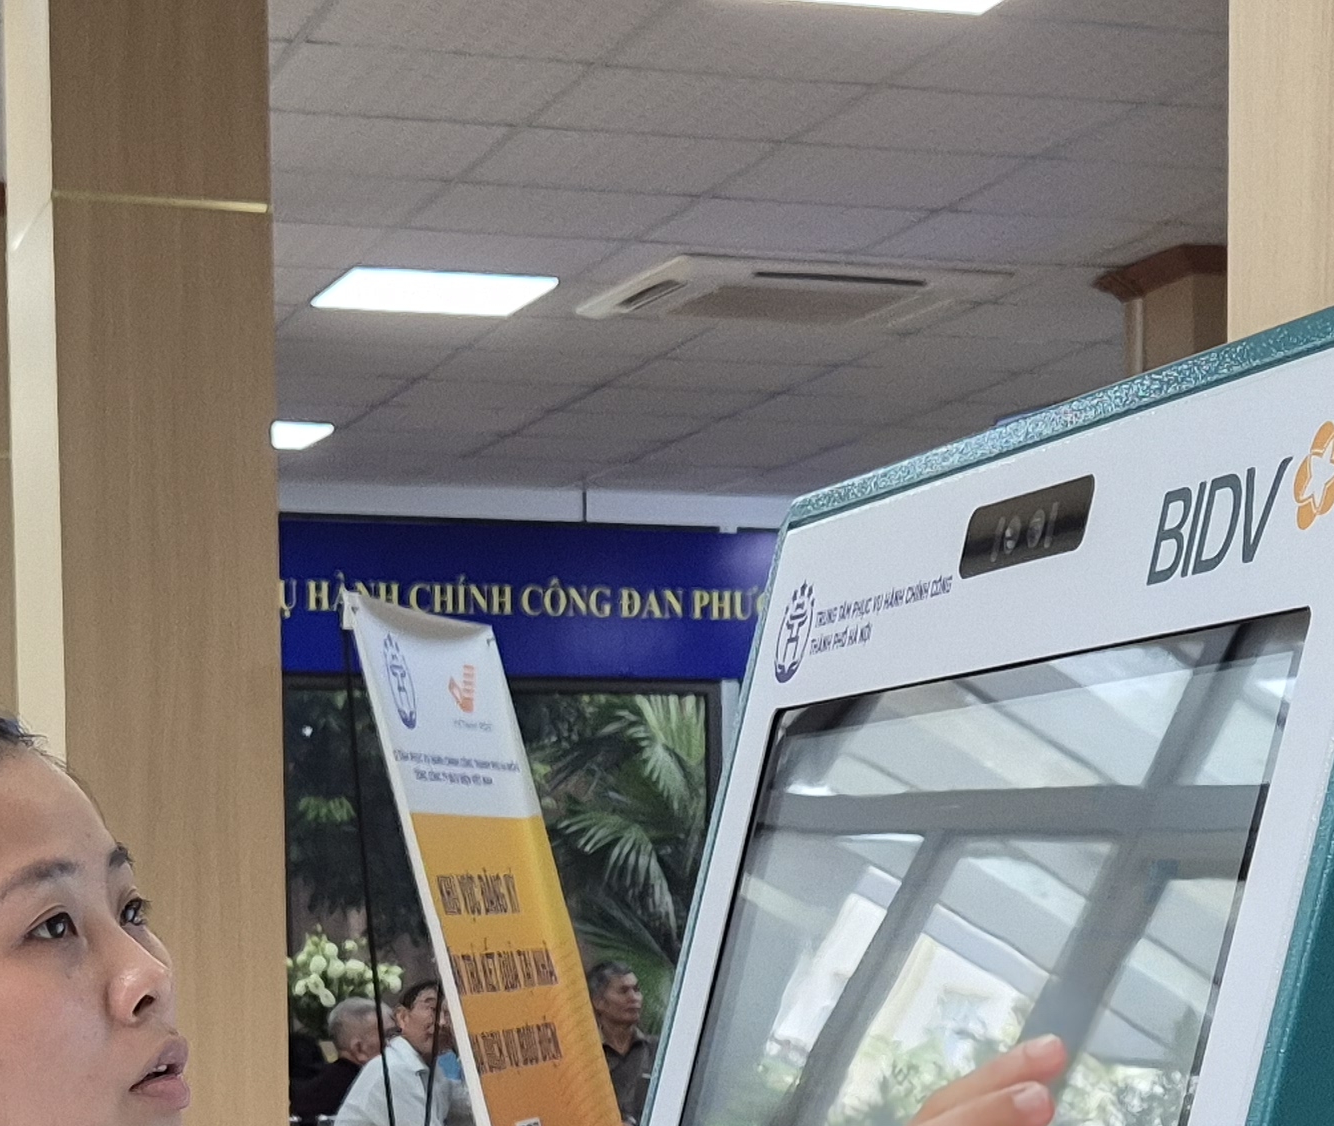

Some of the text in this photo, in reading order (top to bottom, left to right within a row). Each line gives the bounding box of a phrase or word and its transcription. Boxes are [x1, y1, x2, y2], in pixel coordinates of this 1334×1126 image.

[1147, 456, 1293, 586] BIDV
[280, 578, 297, 619] Ụ
[409, 574, 512, 616] CHÍNH
[521, 576, 612, 618] CÔNG
[620, 587, 684, 620] ĐAN
[930, 575, 953, 598] CÔNG
